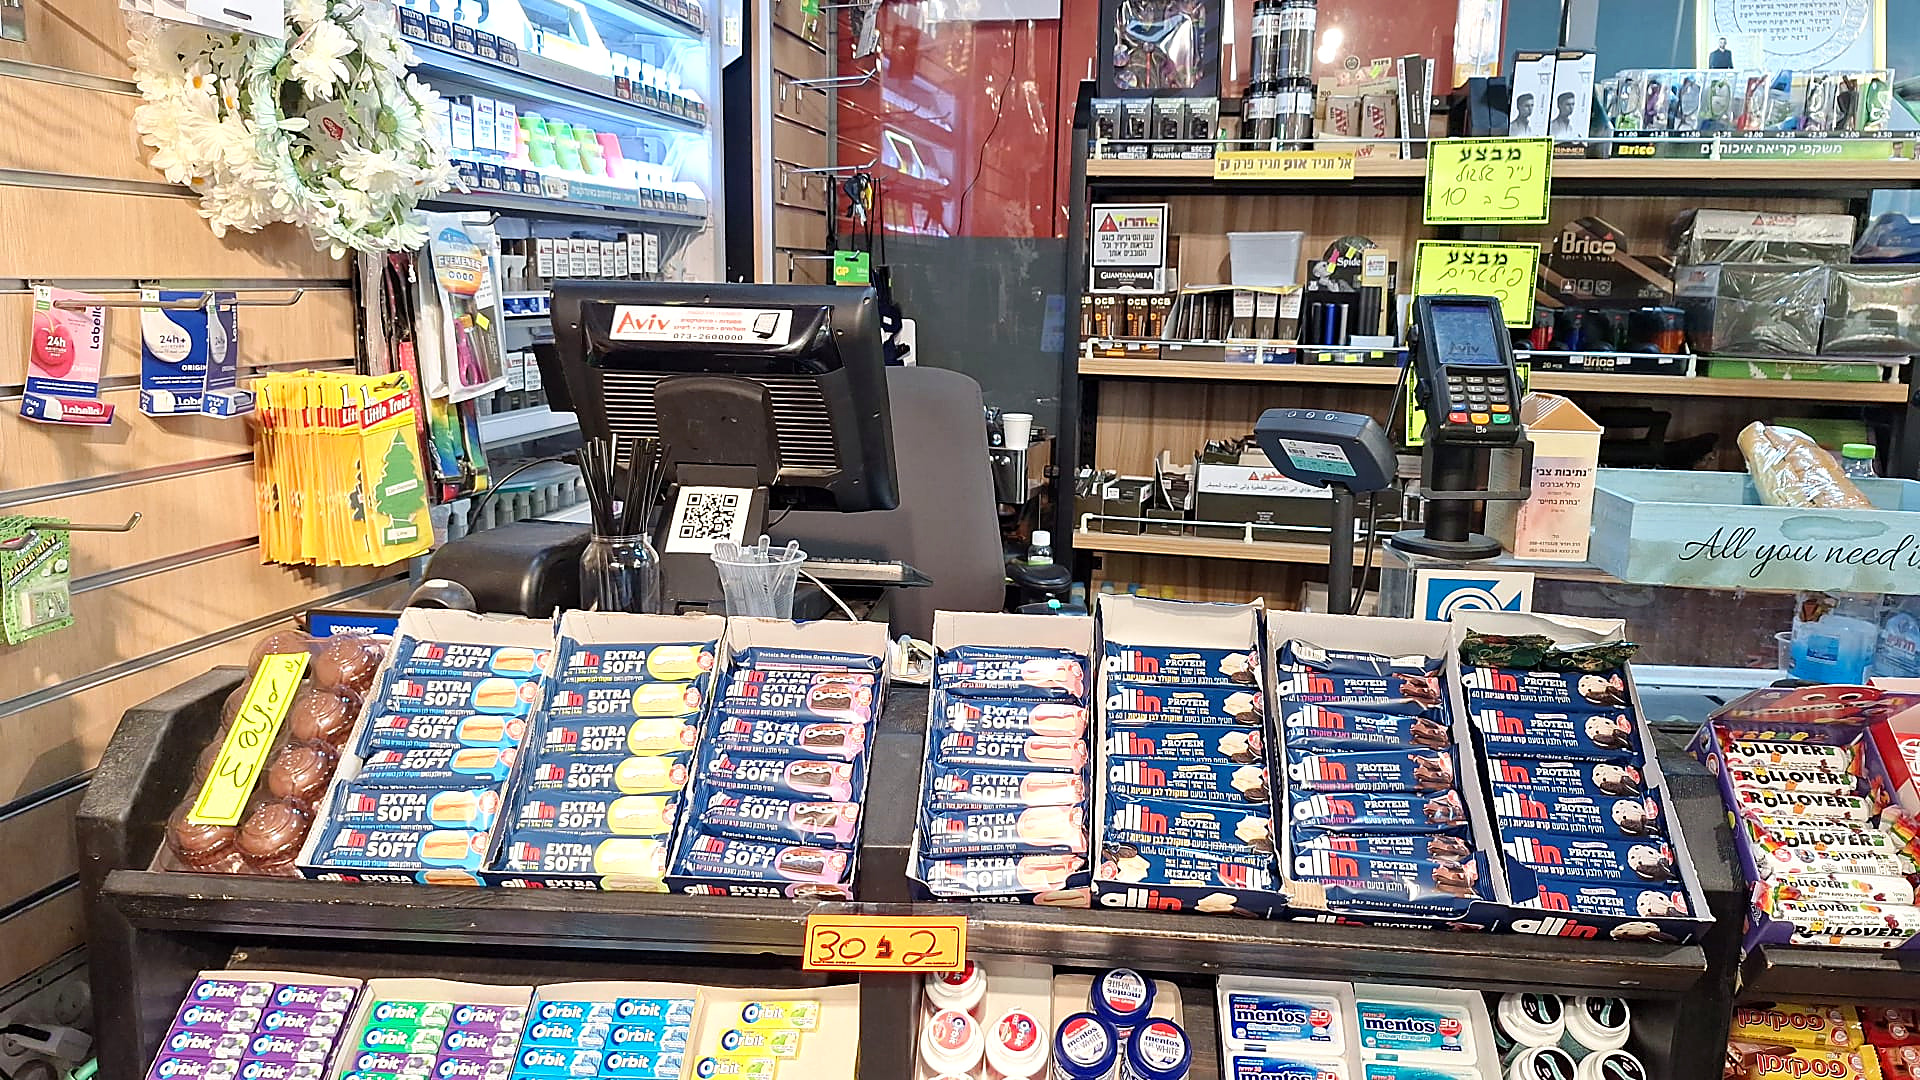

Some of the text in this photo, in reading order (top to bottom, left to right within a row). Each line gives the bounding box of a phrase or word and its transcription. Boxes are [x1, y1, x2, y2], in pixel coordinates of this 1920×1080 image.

[1459, 149, 1521, 163] מבצע
[1756, 143, 1842, 156] משקפי קריאה
[1233, 158, 1254, 171] פרק
[1259, 158, 1280, 169] תגיד
[1312, 158, 1334, 169] תגיד
[1441, 187, 1466, 206] 10
[1498, 186, 1520, 209] 5
[1561, 231, 1617, 255] Brico
[1445, 251, 1508, 266] מבצע
[1101, 271, 1153, 280] GUANTANAMERA
[1095, 296, 1115, 305] OCB
[1127, 298, 1148, 306] OCB
[1150, 297, 1171, 305] OCB
[616, 311, 670, 334] Aviv
[47, 336, 66, 347] 24h
[673, 333, 743, 341] 073-2600000
[63, 404, 100, 416] Labello
[364, 395, 411, 426] Little Trees
[1679, 527, 1920, 578] All you need i
[448, 646, 491, 657] EXTRA
[443, 656, 489, 668] SOFT
[1165, 659, 1206, 667] PROTEIN
[427, 681, 472, 692] EXTRA
[1461, 668, 1517, 692] allin
[726, 682, 758, 697] allin
[424, 692, 470, 706] SOFT
[983, 705, 1028, 715] EXTRA
[982, 716, 1027, 729] SOFT
[1202, 716, 1216, 724] חלבון
[1218, 716, 1232, 724] חטיף
[1531, 720, 1574, 729] PROTEIN
[1289, 756, 1347, 781] allin
[972, 775, 1019, 785] EXTRA
[1173, 771, 1216, 781] PROTEIN
[971, 786, 1018, 801] SOFT
[739, 803, 789, 821] SOFT
[968, 814, 1015, 826] EXTRA
[1175, 818, 1220, 830] PROTEIN
[1568, 848, 1616, 859] PROTEIN
[544, 856, 591, 872] SOFT
[1295, 850, 1358, 877] allin
[501, 879, 544, 890] allin
[545, 879, 597, 890] EXTRA
[1511, 917, 1598, 938] allin
[816, 930, 867, 964] 30
[902, 930, 944, 965] 2
[197, 983, 239, 998] Orbit
[1108, 979, 1131, 990] WHITE
[1106, 987, 1141, 999] mentos
[184, 1008, 225, 1023] Orbit
[541, 1003, 583, 1020] Orbit
[620, 1001, 661, 1018] Orbit
[1236, 1007, 1328, 1024] mentos 30
[1364, 1017, 1458, 1034] mentos 30
[366, 1028, 407, 1044] Orbit
[722, 1029, 765, 1051] Orbit
[1067, 1026, 1098, 1049] mentos
[1080, 1031, 1103, 1048] WHITE
[1145, 1035, 1180, 1048] mentos
[253, 1037, 295, 1053] Orbit
[1156, 1044, 1180, 1056] WHITE
[523, 1050, 566, 1068] Orbit
